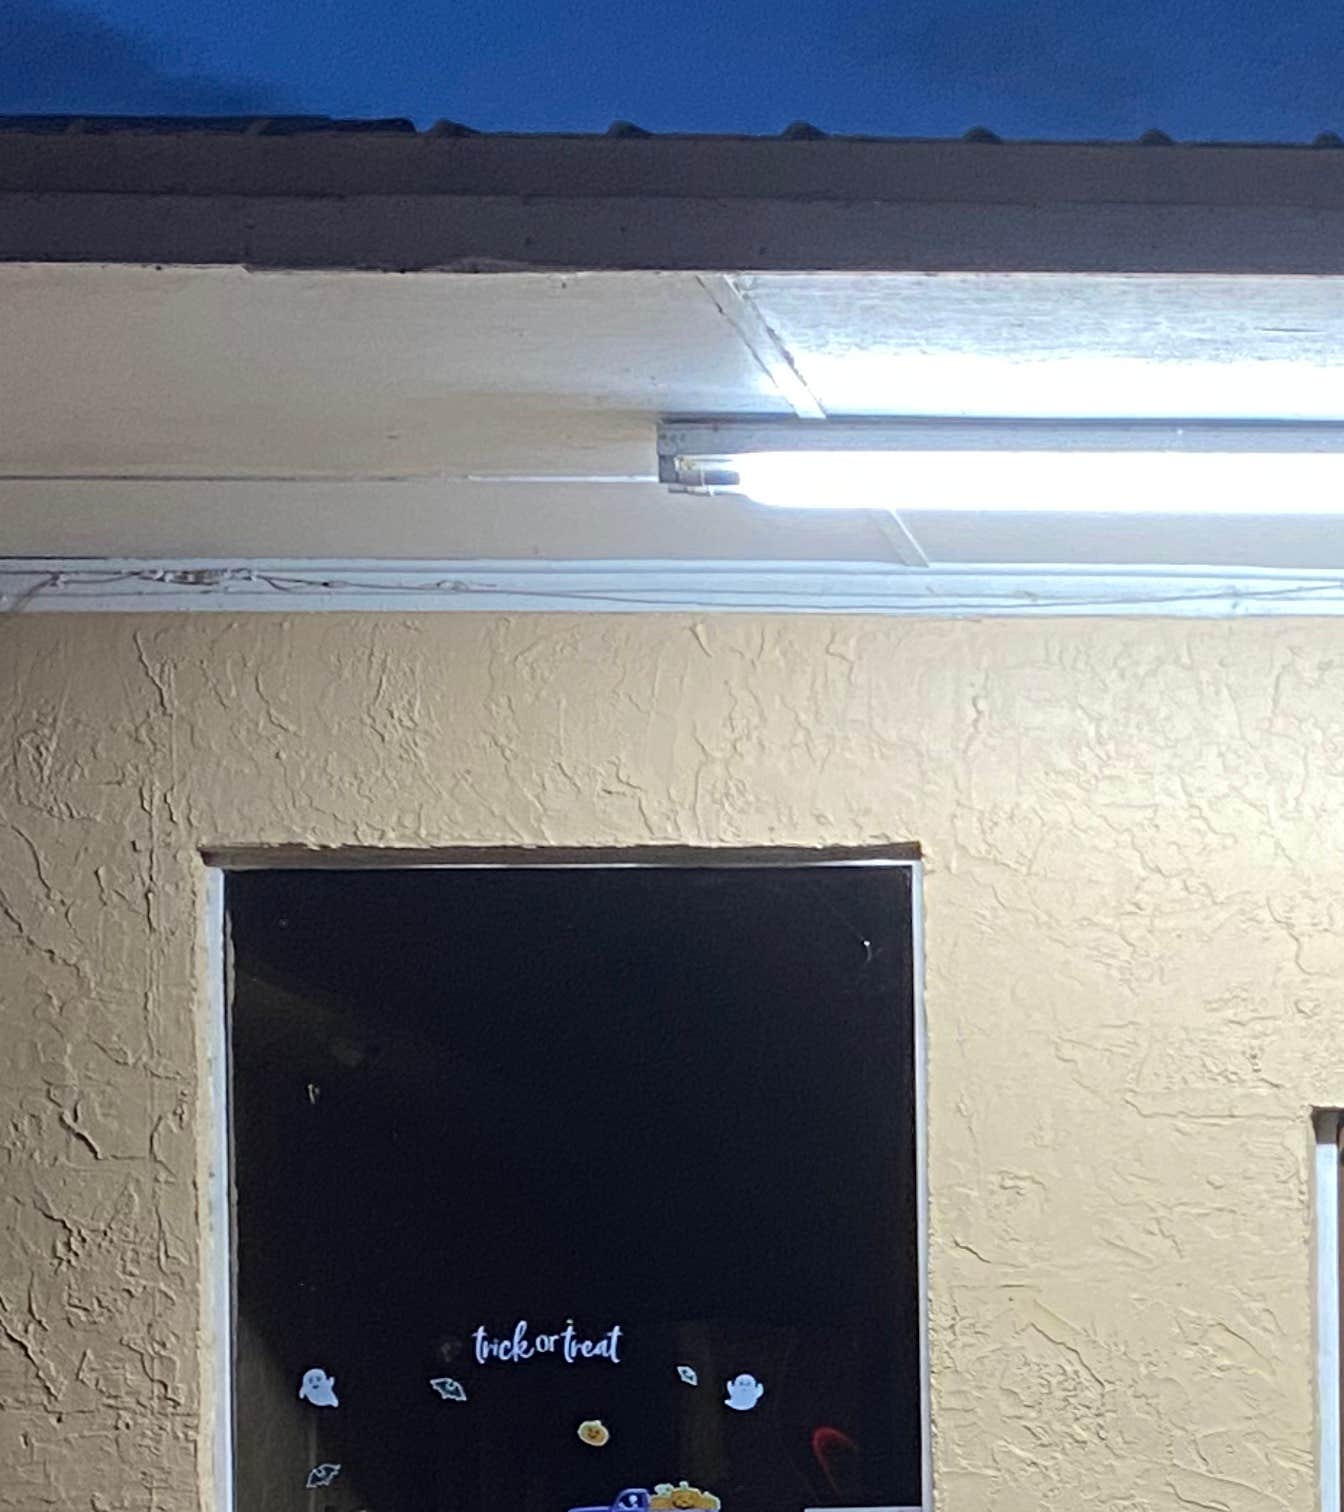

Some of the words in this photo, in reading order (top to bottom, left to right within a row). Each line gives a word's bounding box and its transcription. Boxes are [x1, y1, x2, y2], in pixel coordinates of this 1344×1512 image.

[472, 1319, 534, 1364] trick
[536, 1333, 560, 1352] or
[560, 1325, 624, 1364] treat
